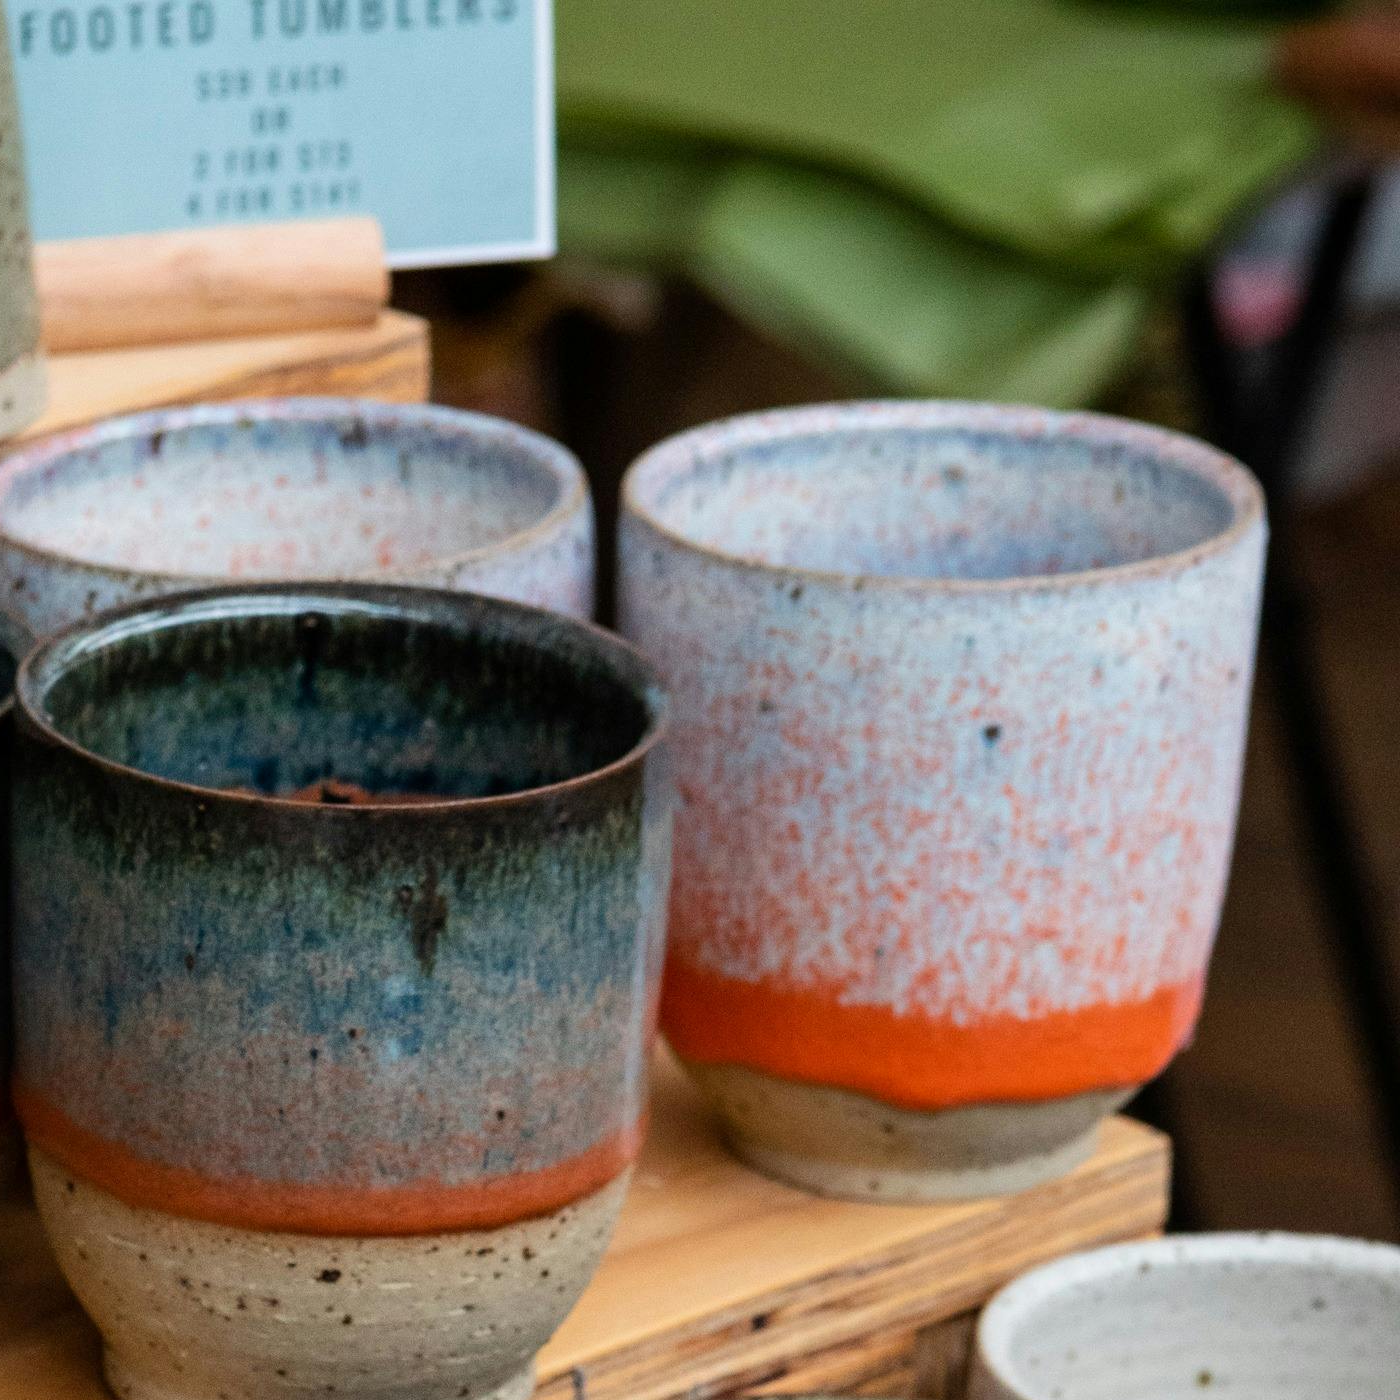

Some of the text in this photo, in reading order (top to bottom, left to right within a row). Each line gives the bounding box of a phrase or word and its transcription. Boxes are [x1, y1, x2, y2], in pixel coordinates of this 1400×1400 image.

[19, 0, 214, 56] FOOTED
[268, 63, 343, 95] EACH
[252, 106, 290, 134] OR
[224, 145, 278, 175] FOR
[217, 185, 271, 214] FOR
